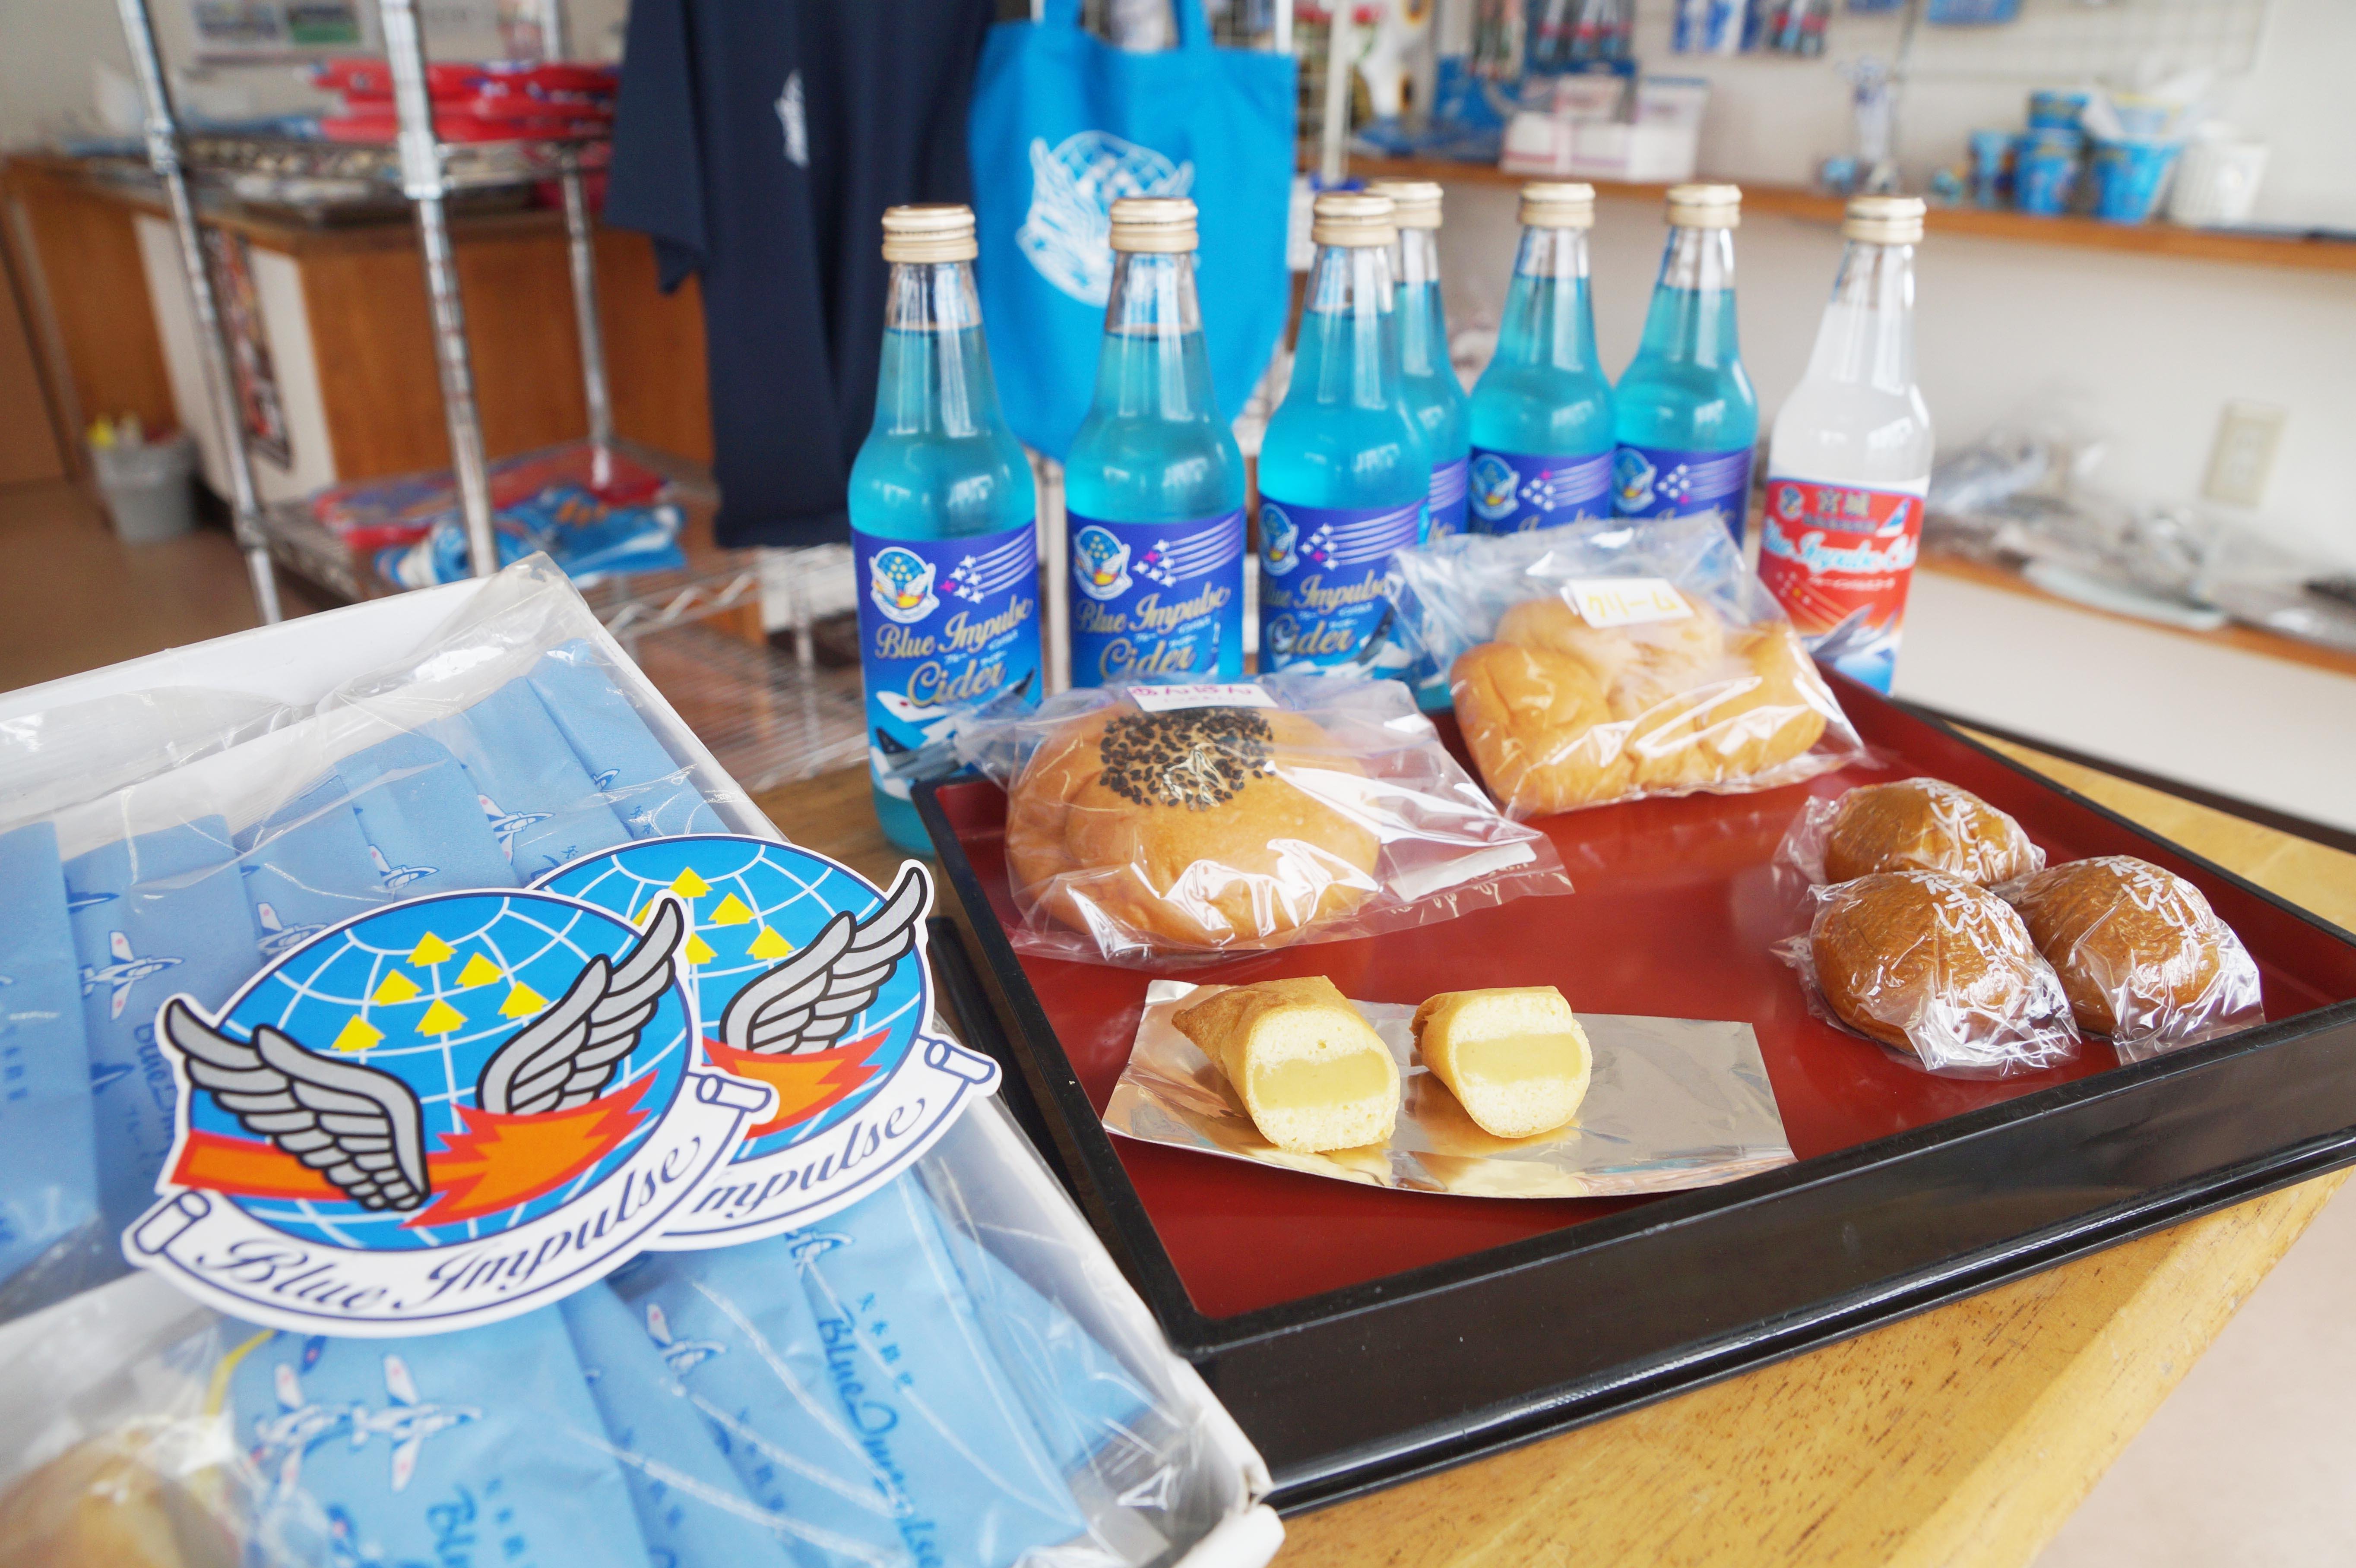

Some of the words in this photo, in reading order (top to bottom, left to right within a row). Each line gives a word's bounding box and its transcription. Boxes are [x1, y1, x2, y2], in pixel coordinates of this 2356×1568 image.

[874, 623, 935, 659] Blue
[937, 594, 1034, 654] Impulse
[1128, 581, 1231, 635] Impulse
[1267, 613, 1356, 655] Cider
[908, 659, 1007, 708] Cider
[1099, 637, 1197, 680] Cider
[691, 1097, 926, 1219] mpulse
[196, 1238, 388, 1311] Blue
[392, 1135, 701, 1311] Impulse
